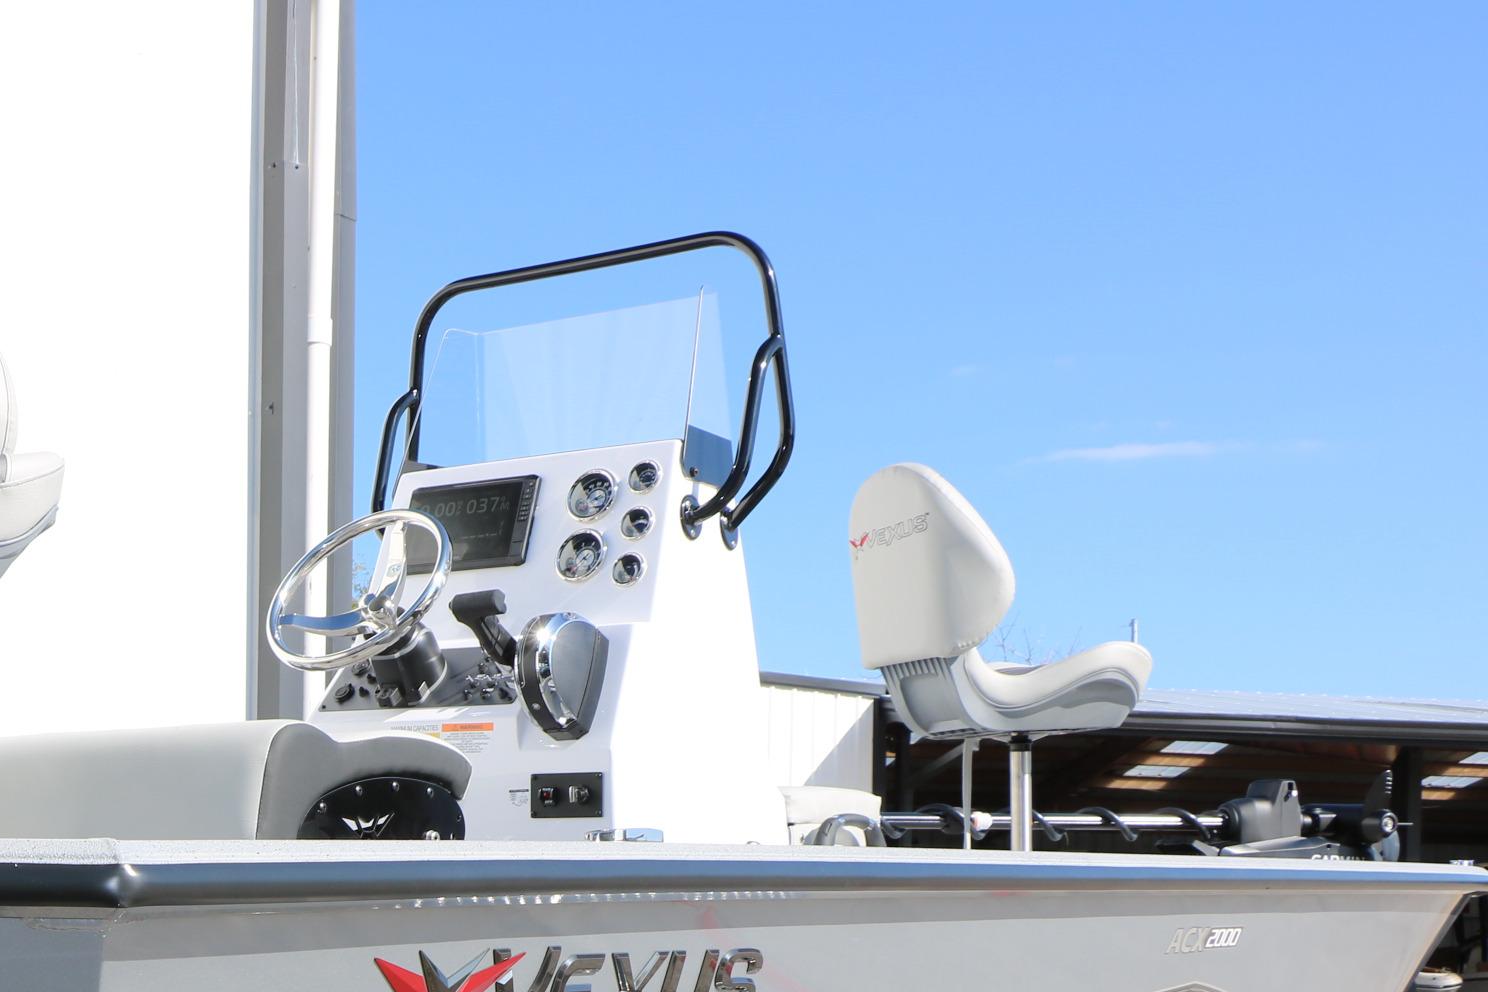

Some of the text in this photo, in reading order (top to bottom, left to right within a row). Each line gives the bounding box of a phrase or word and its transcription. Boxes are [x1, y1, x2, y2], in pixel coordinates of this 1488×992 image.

[866, 513, 929, 549] VEXUS
[1165, 927, 1243, 954] ACX 2000
